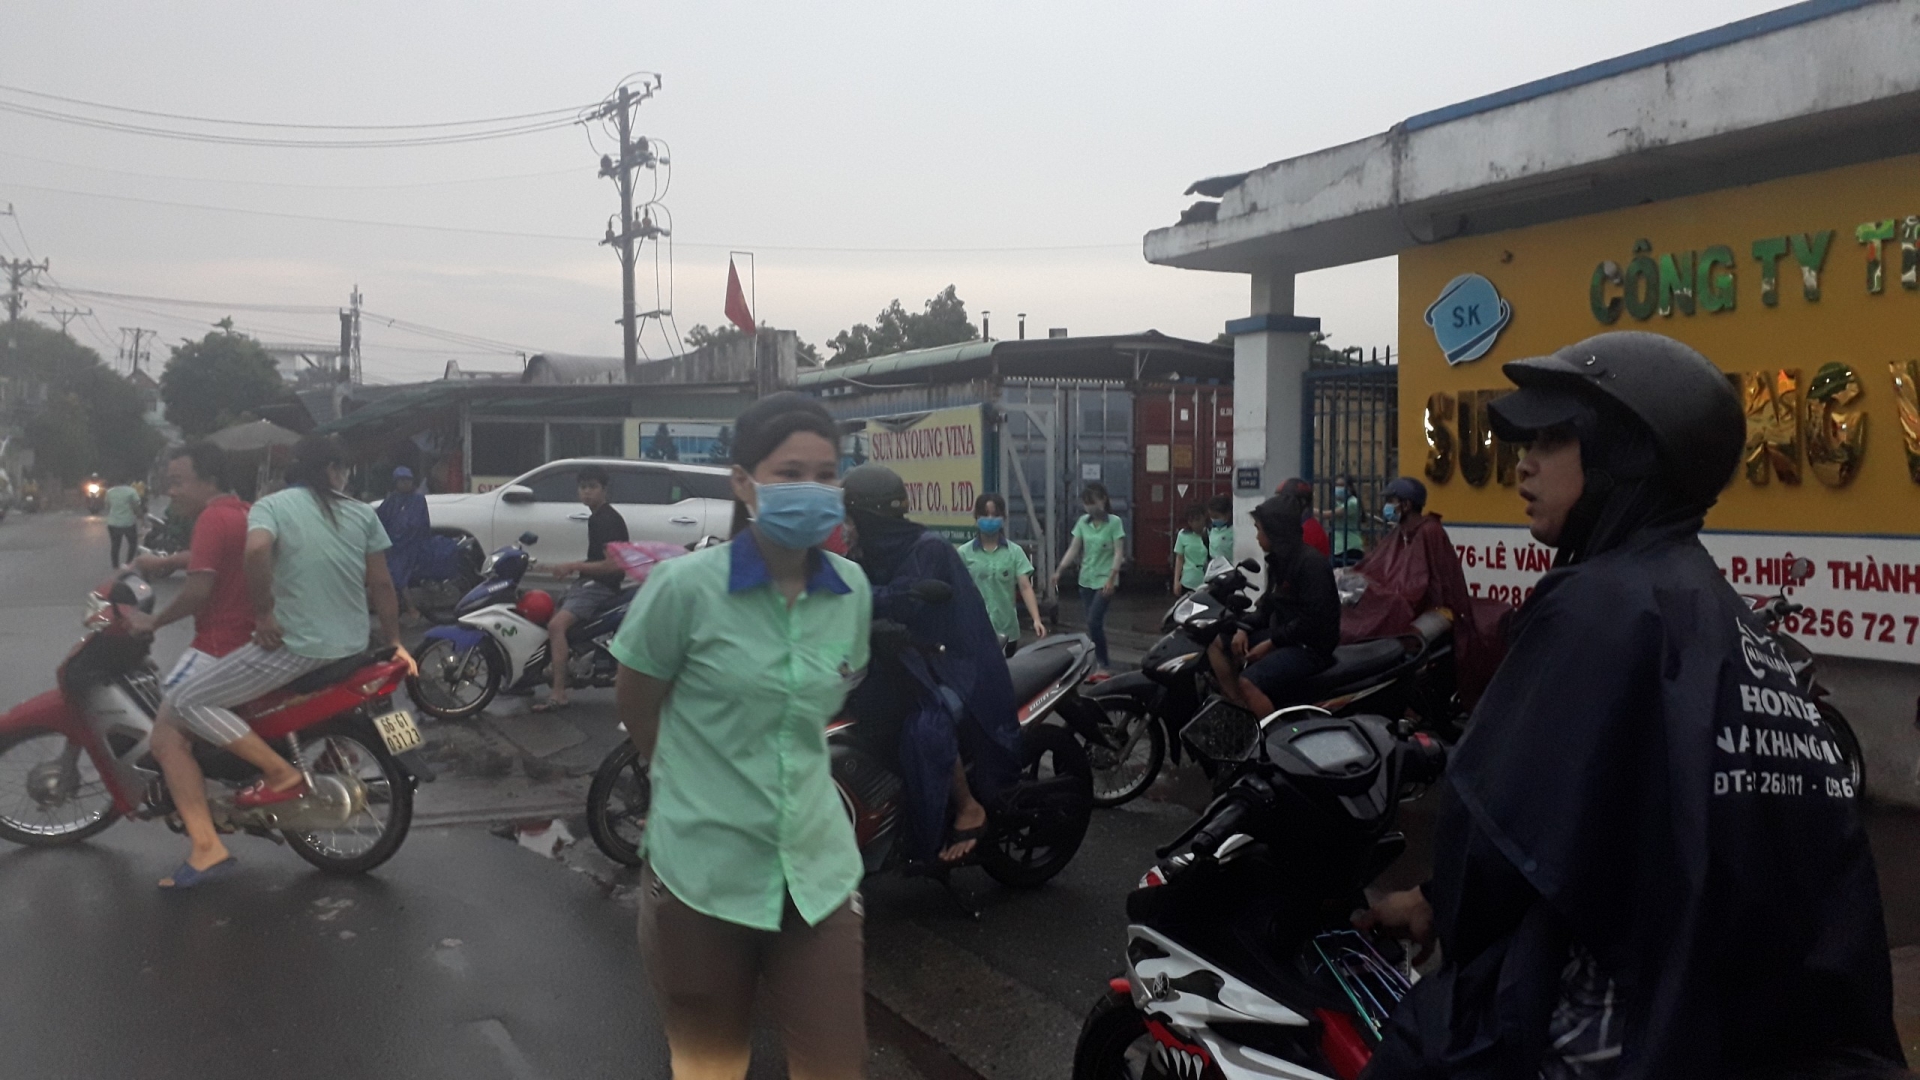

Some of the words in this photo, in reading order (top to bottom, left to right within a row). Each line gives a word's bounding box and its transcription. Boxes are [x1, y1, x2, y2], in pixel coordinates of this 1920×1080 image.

[1590, 238, 1735, 324] CÔNG
[1752, 230, 1835, 307] TY
[872, 431, 893, 461] SUN
[896, 427, 943, 459] KYOUNG
[945, 424, 976, 456] VINA
[1424, 389, 1518, 487] SU
[1724, 360, 1867, 488] NG
[905, 482, 923, 512] NT
[951, 481, 974, 512] LTD
[1514, 543, 1551, 572] VĂN
[1828, 555, 1920, 594] THÀNH
